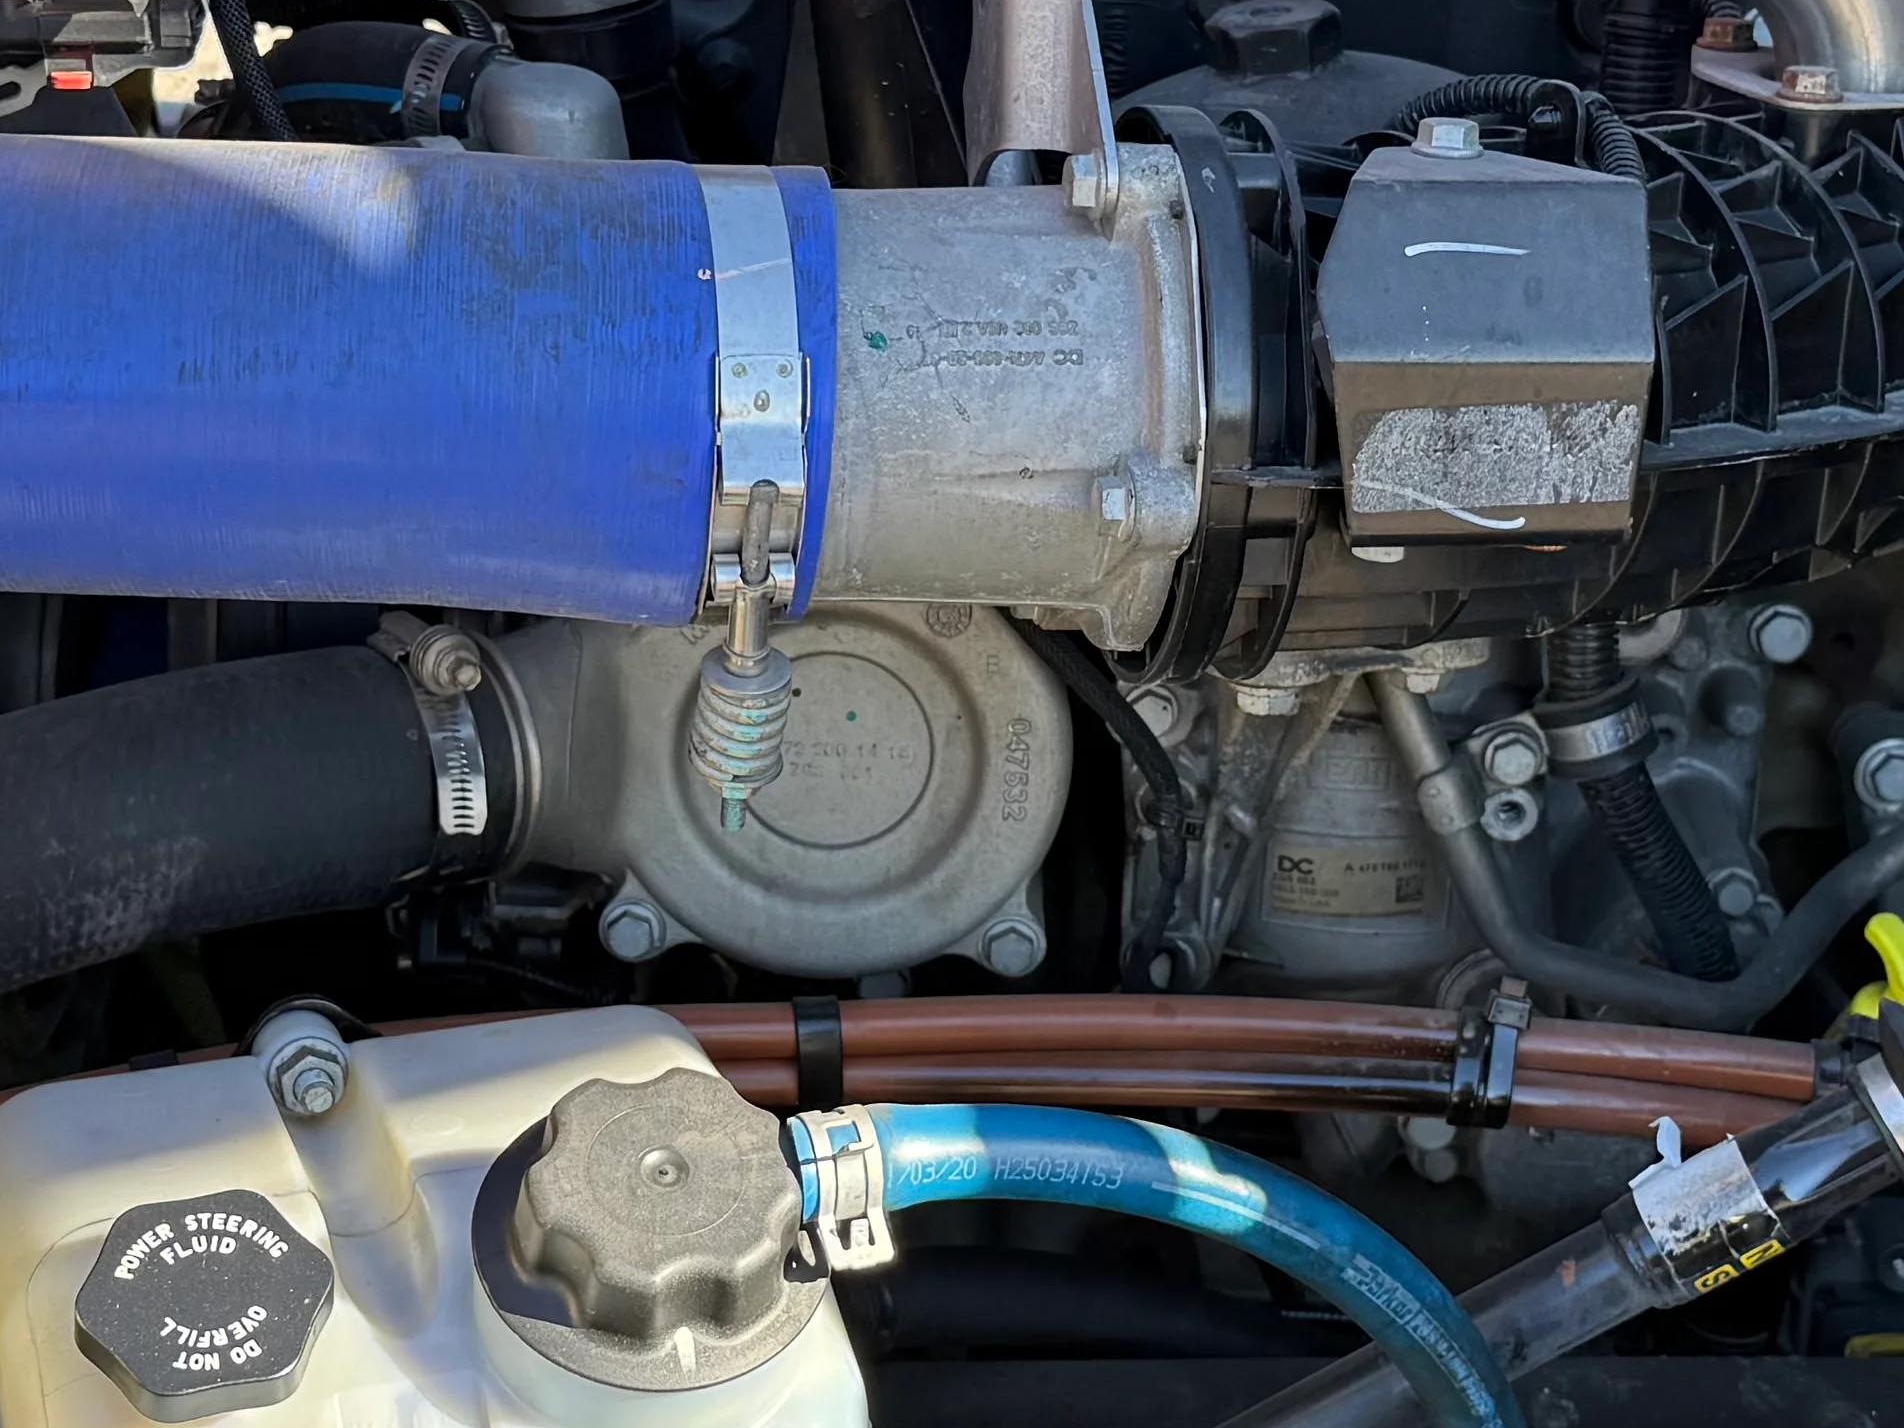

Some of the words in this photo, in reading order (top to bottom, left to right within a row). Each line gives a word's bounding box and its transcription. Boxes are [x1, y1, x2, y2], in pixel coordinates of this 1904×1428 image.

[1002, 717, 1032, 824] 047532
[1277, 854, 1314, 876] DC
[114, 1222, 175, 1281] POWER
[184, 1212, 290, 1259] STEERING
[159, 1234, 237, 1266] FLUID
[1700, 1269, 1734, 1290] S
[159, 1304, 269, 1349] OVERFILL
[171, 1350, 221, 1372] NOT
[229, 1338, 264, 1365] DO
